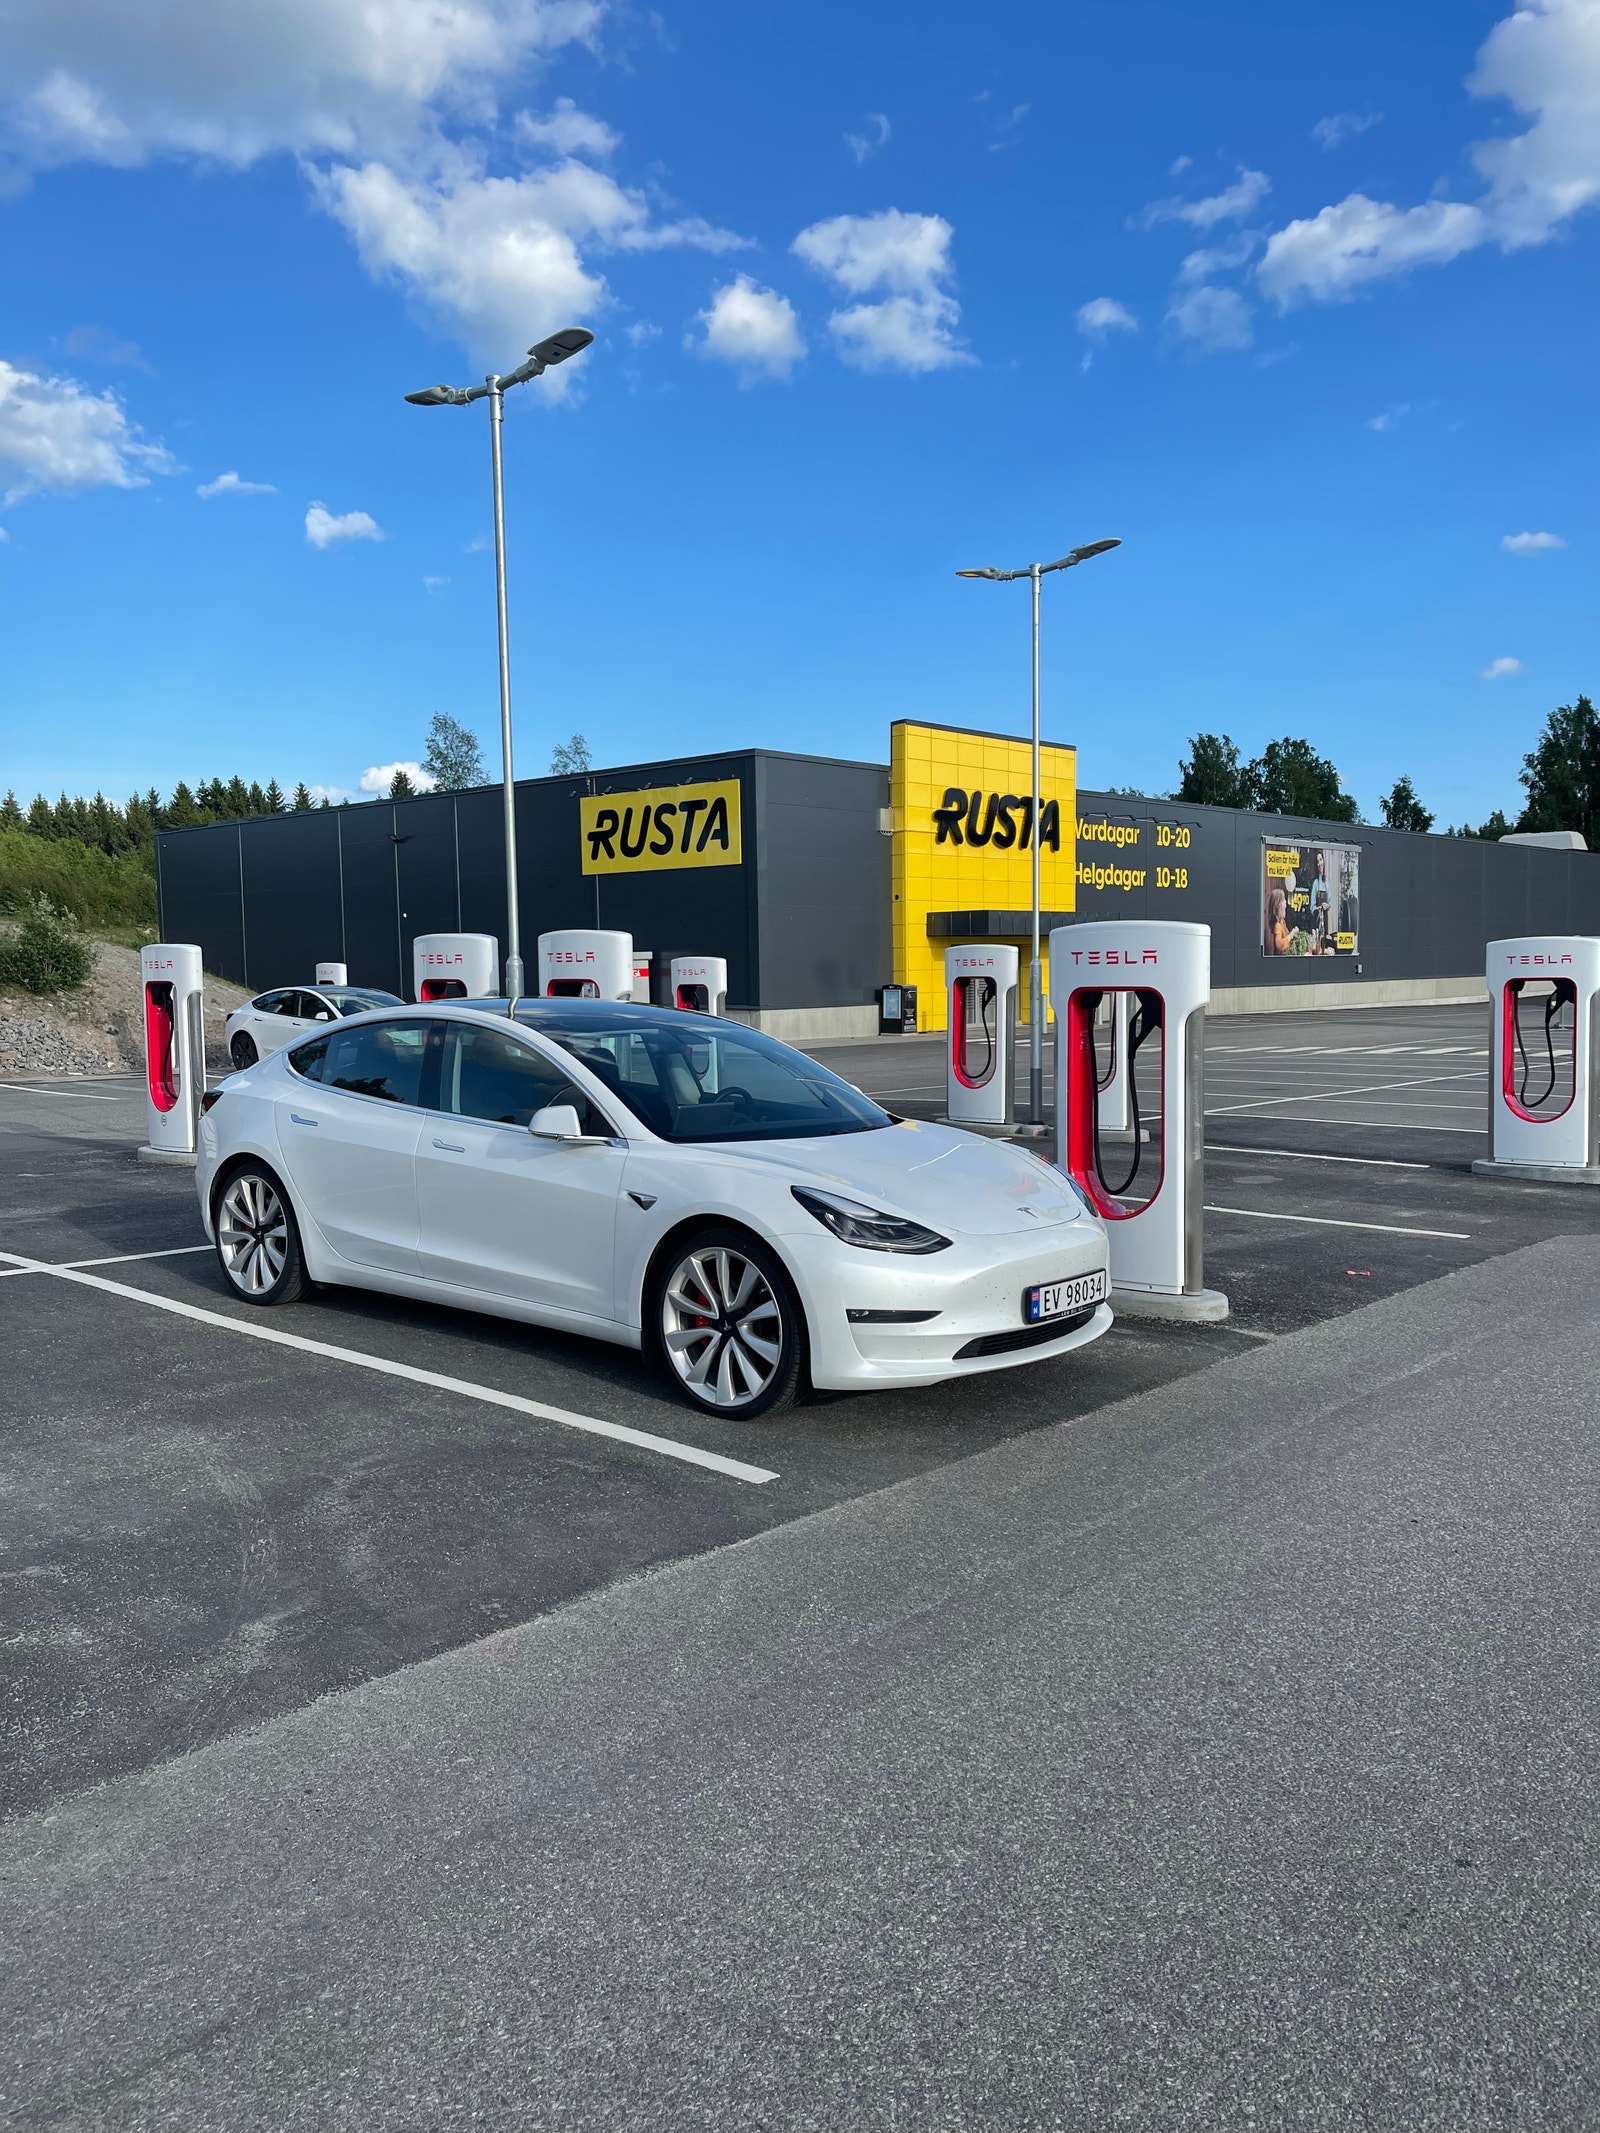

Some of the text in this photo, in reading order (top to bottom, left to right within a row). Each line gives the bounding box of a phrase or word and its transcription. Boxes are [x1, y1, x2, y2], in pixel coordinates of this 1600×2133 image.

[932, 787, 1060, 852] RUSTA
[587, 796, 730, 861] RUSTA
[1075, 818, 1191, 848] Vardagar 10-20
[1075, 862, 1188, 891] Helgdagar 10-18
[421, 953, 462, 964] TESLA
[548, 952, 594, 963] TESLA
[955, 958, 994, 967] TESLA
[1071, 949, 1157, 965] TESLA
[1506, 954, 1572, 965] TESLA
[144, 960, 173, 969] TESLA
[677, 968, 706, 976] TESLA
[1044, 1275, 1102, 1312] EV 98034
